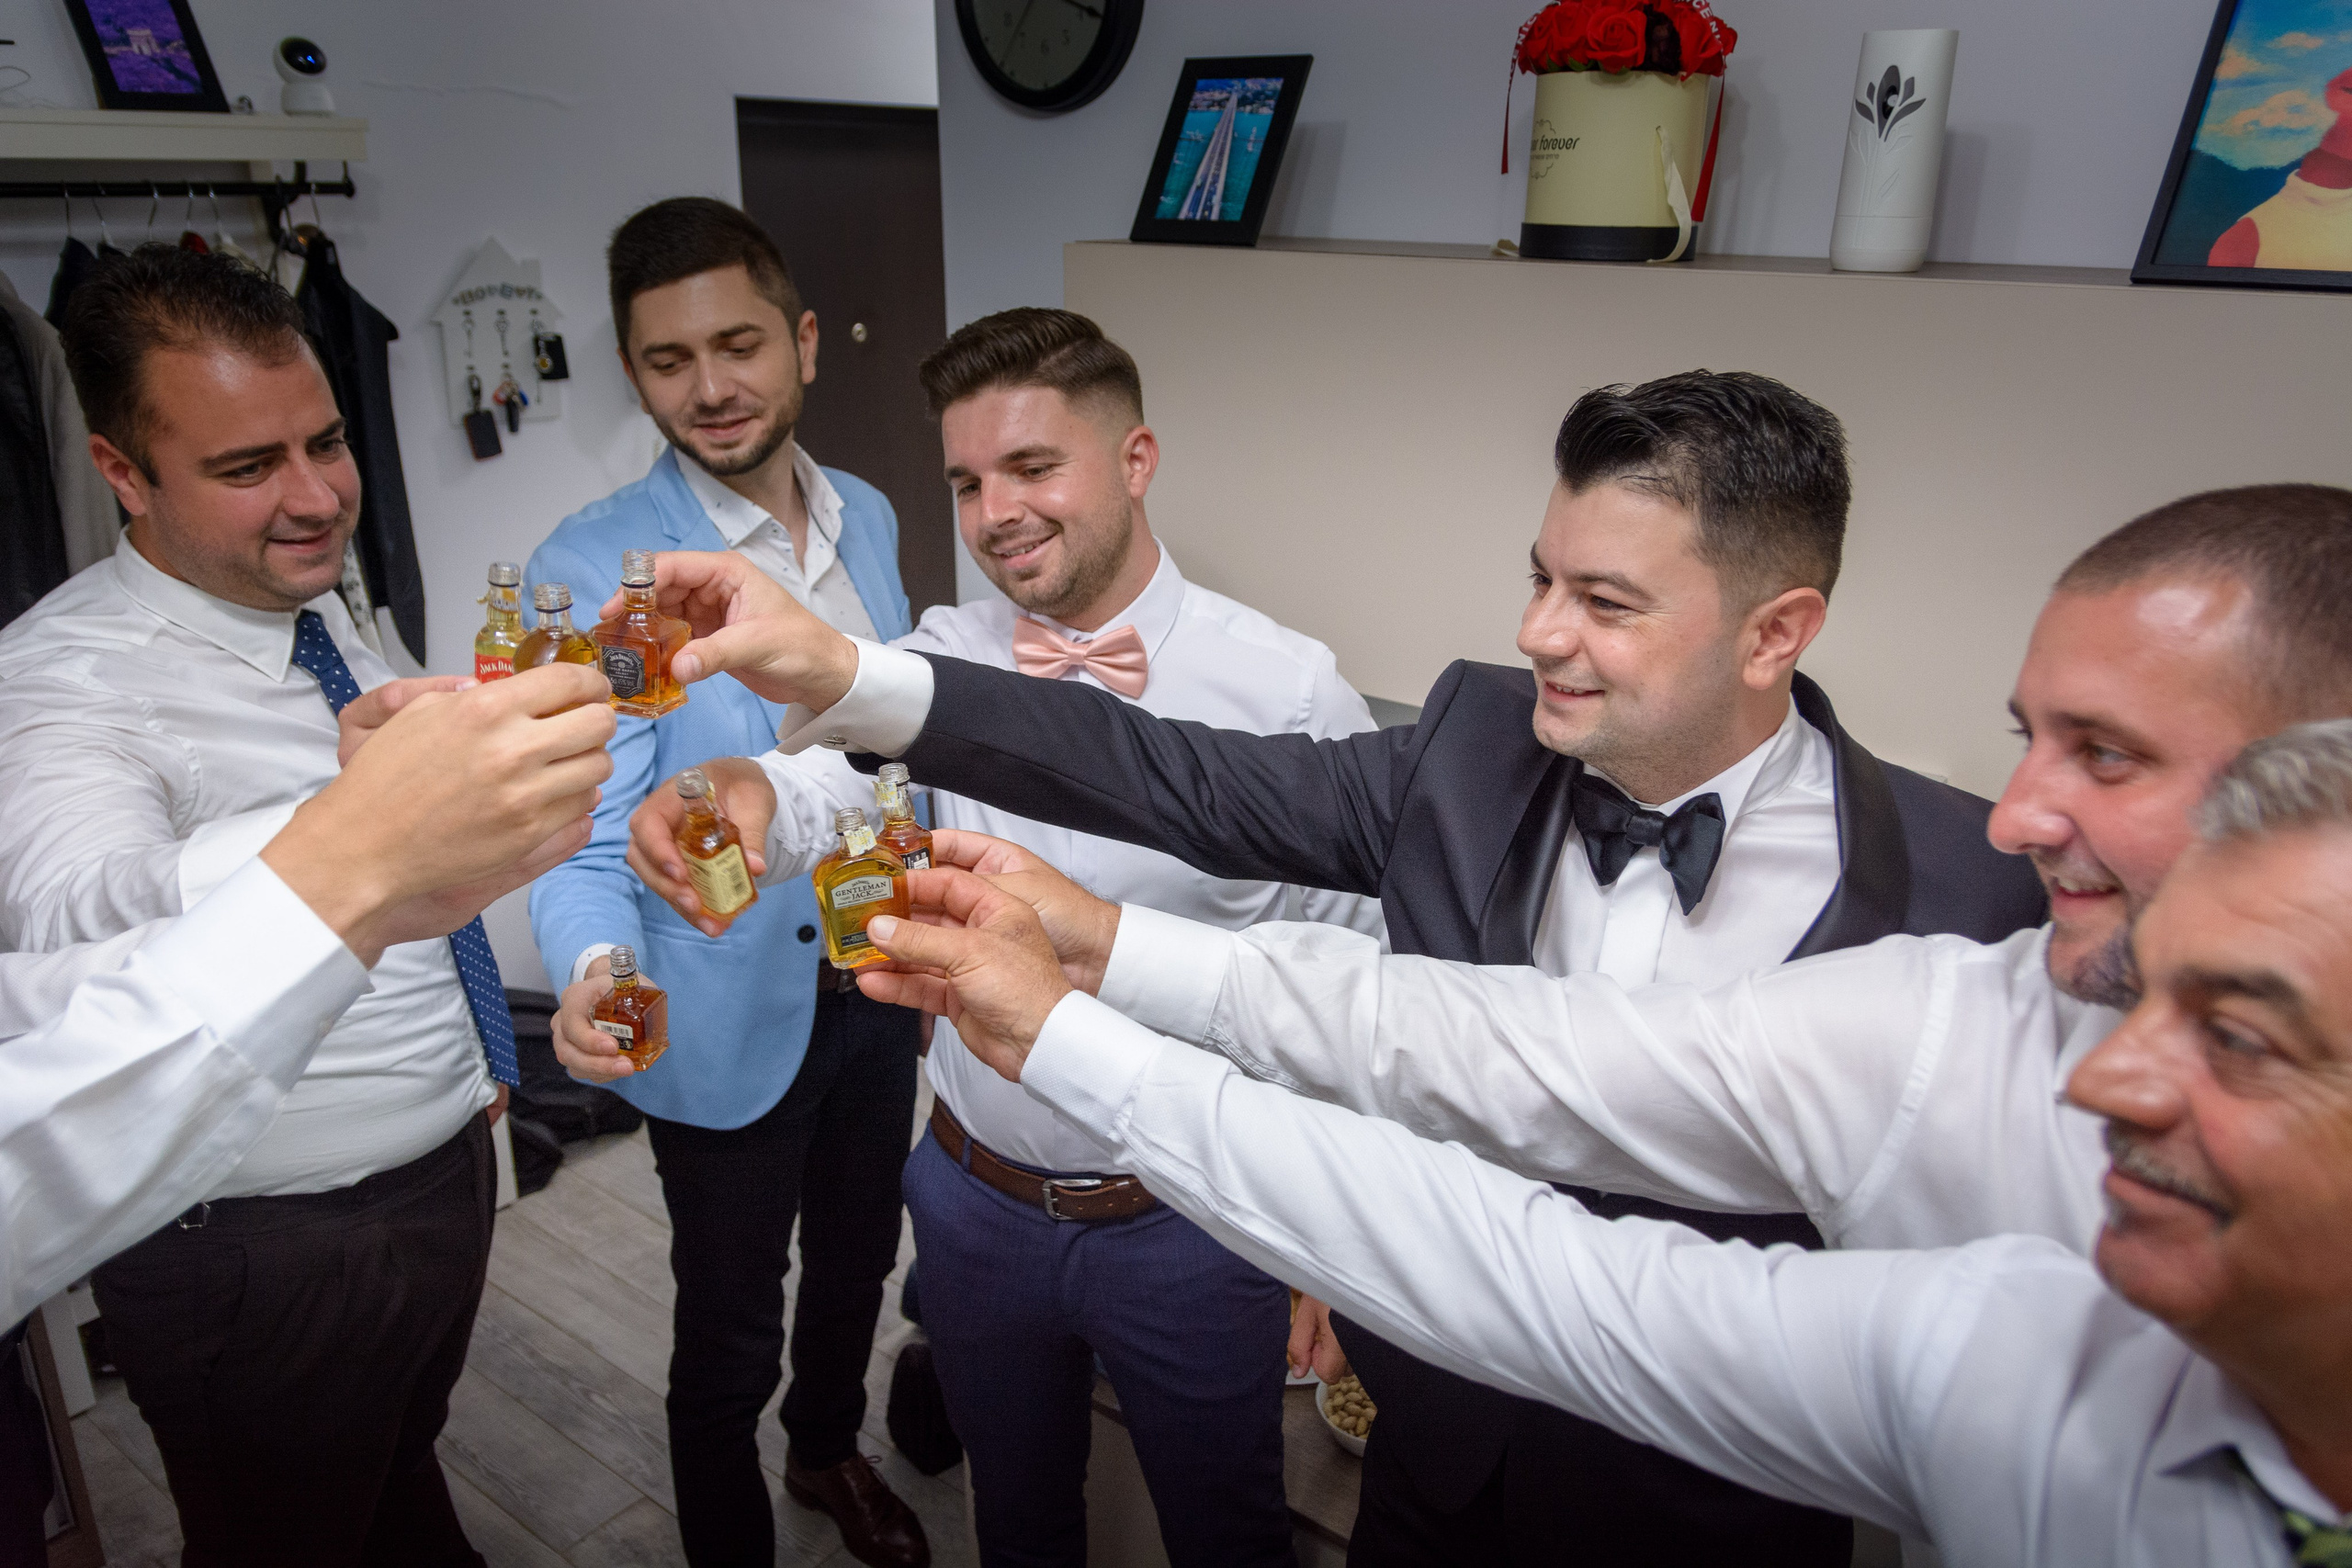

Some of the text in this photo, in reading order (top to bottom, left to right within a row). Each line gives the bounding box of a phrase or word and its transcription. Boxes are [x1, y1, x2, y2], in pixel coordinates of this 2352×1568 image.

[1539, 134, 1580, 151] forever
[480, 660, 514, 674] JACK DAN
[835, 881, 887, 897] GENTLEMAN
[852, 890, 873, 900] JACK
